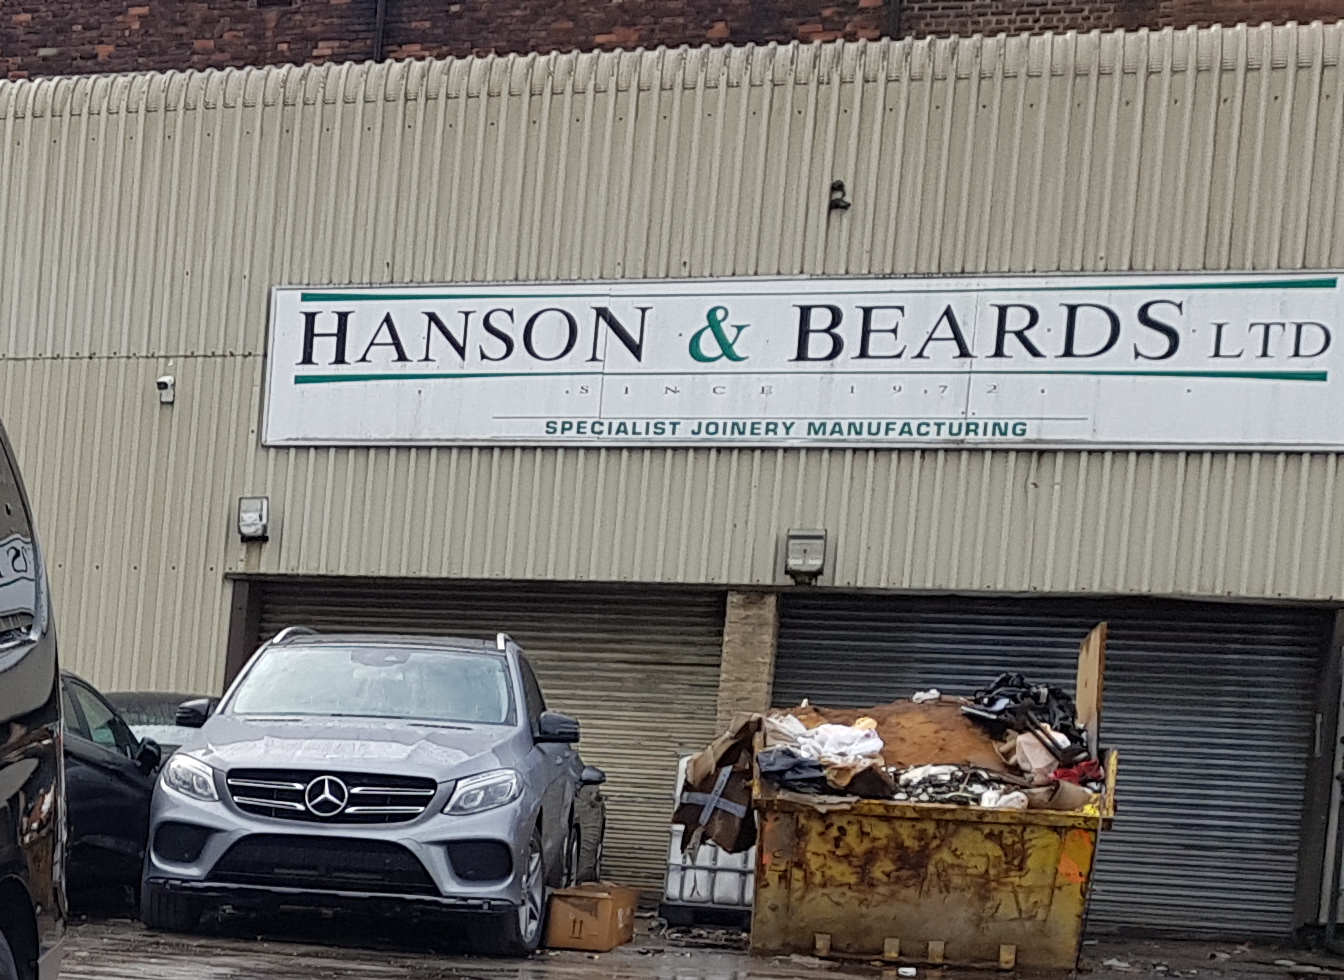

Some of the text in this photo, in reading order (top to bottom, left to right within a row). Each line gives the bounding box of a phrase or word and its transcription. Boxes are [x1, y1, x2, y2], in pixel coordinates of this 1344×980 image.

[294, 299, 1332, 366] HANSON & BEARDS LTD
[544, 420, 1028, 437] SPECIALIST JOINERY MANUFACTURING
